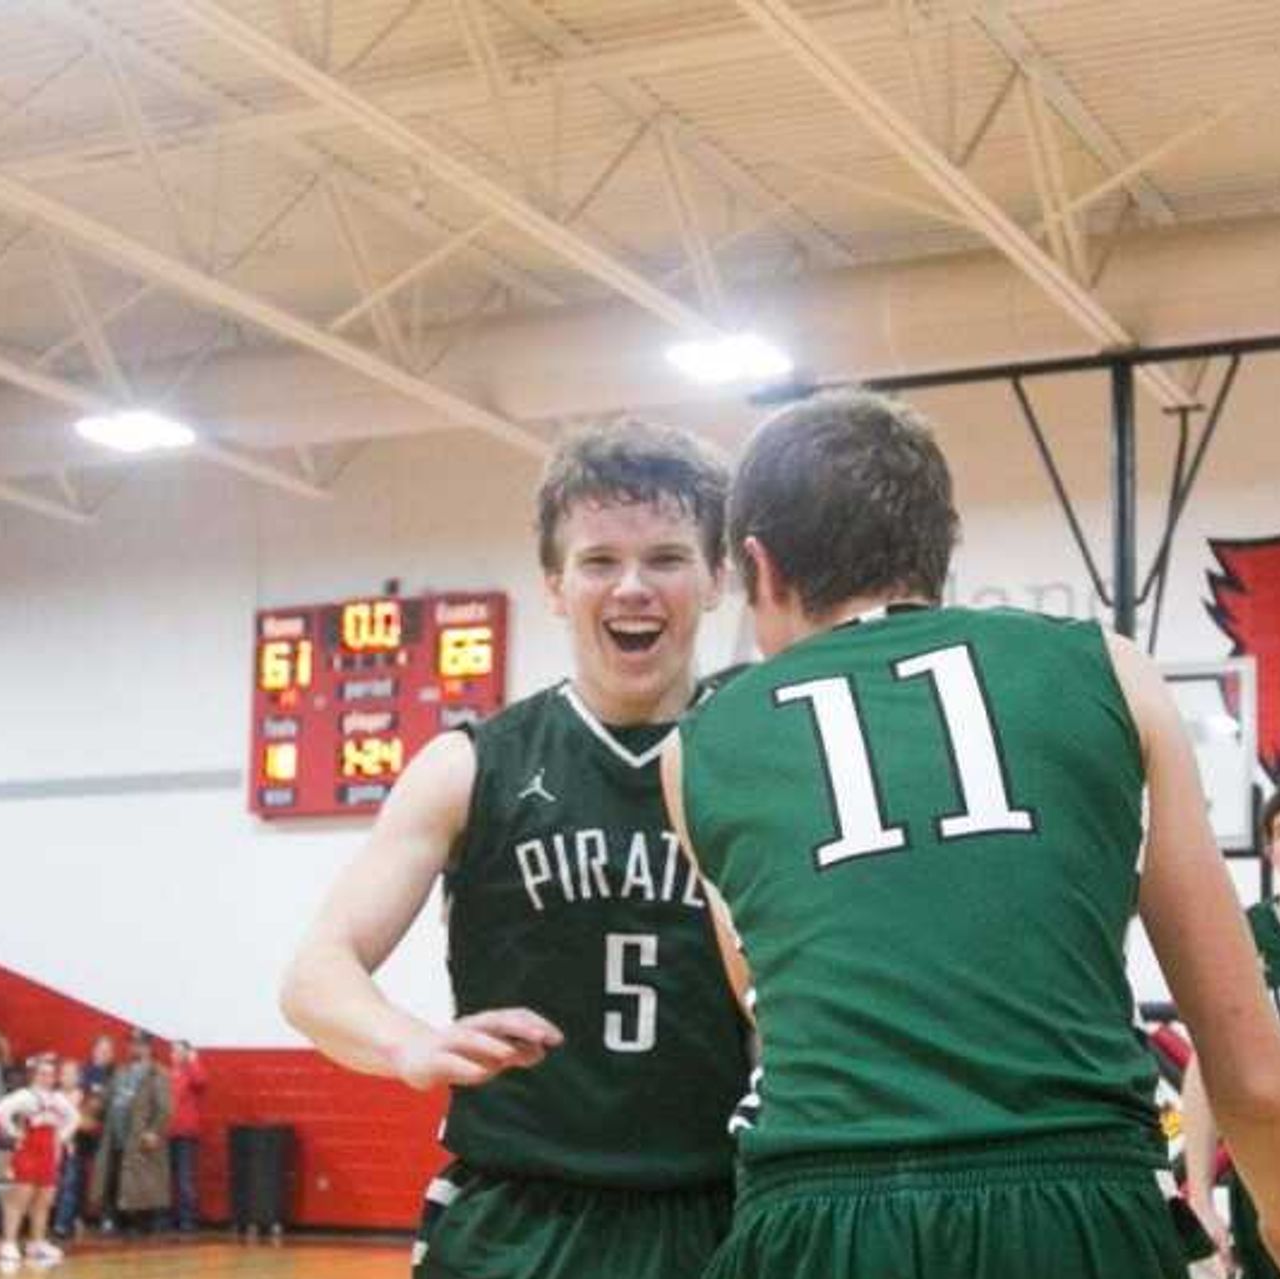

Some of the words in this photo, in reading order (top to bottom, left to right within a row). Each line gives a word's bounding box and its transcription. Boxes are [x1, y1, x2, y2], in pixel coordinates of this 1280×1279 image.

[262, 640, 313, 690] 61
[440, 627, 494, 678] 66
[774, 643, 1034, 868] 11
[515, 828, 706, 911] PIRAT
[603, 933, 659, 1053] 5
